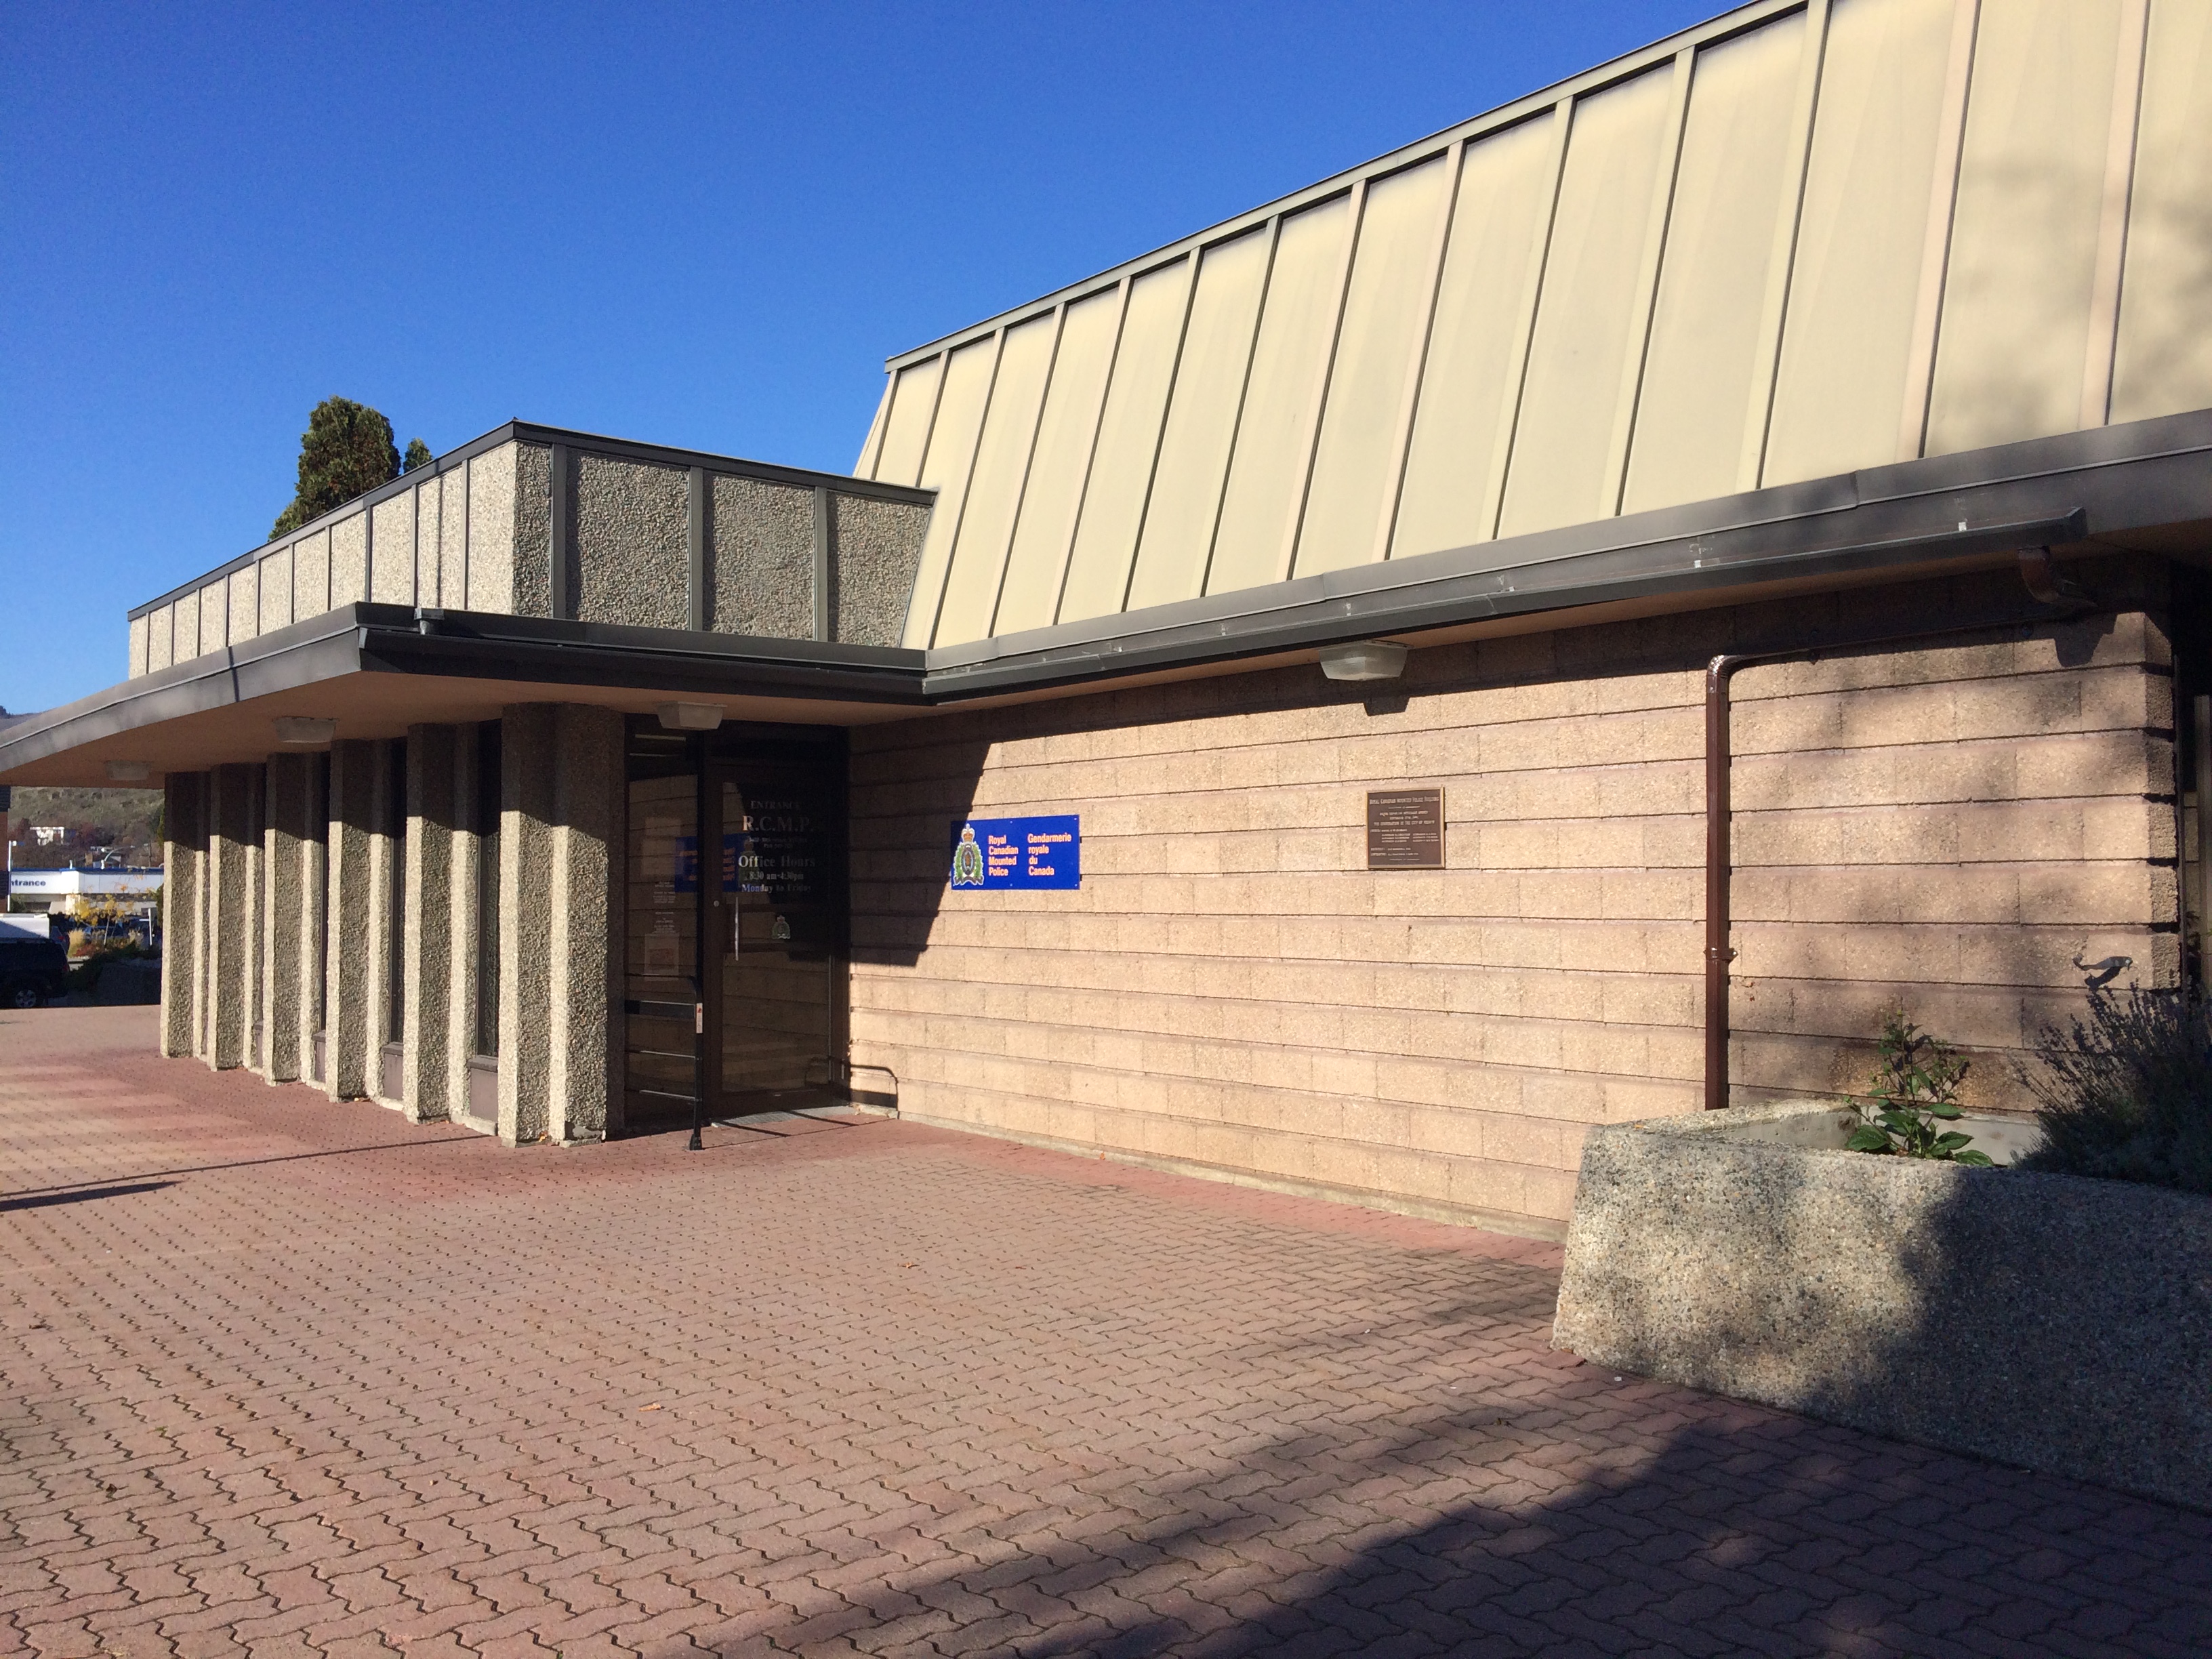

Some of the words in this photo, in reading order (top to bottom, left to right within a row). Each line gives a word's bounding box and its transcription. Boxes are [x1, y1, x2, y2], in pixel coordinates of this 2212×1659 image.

[750, 800, 802, 809] ENTRANCE
[742, 815, 813, 832] R.C.M.P.
[988, 835, 1006, 846] Royal
[1027, 833, 1072, 844] Gendarmerie
[988, 846, 1019, 855] Canadian
[1028, 844, 1049, 856] royale
[738, 855, 775, 867] Office
[781, 855, 815, 867] Hours
[988, 856, 1017, 865] Mounted
[1029, 855, 1038, 865] du
[989, 867, 1008, 876] Police
[1028, 866, 1054, 876] Canada
[741, 884, 773, 893] Monday
[776, 884, 784, 892] to
[787, 884, 812, 893] Friday
